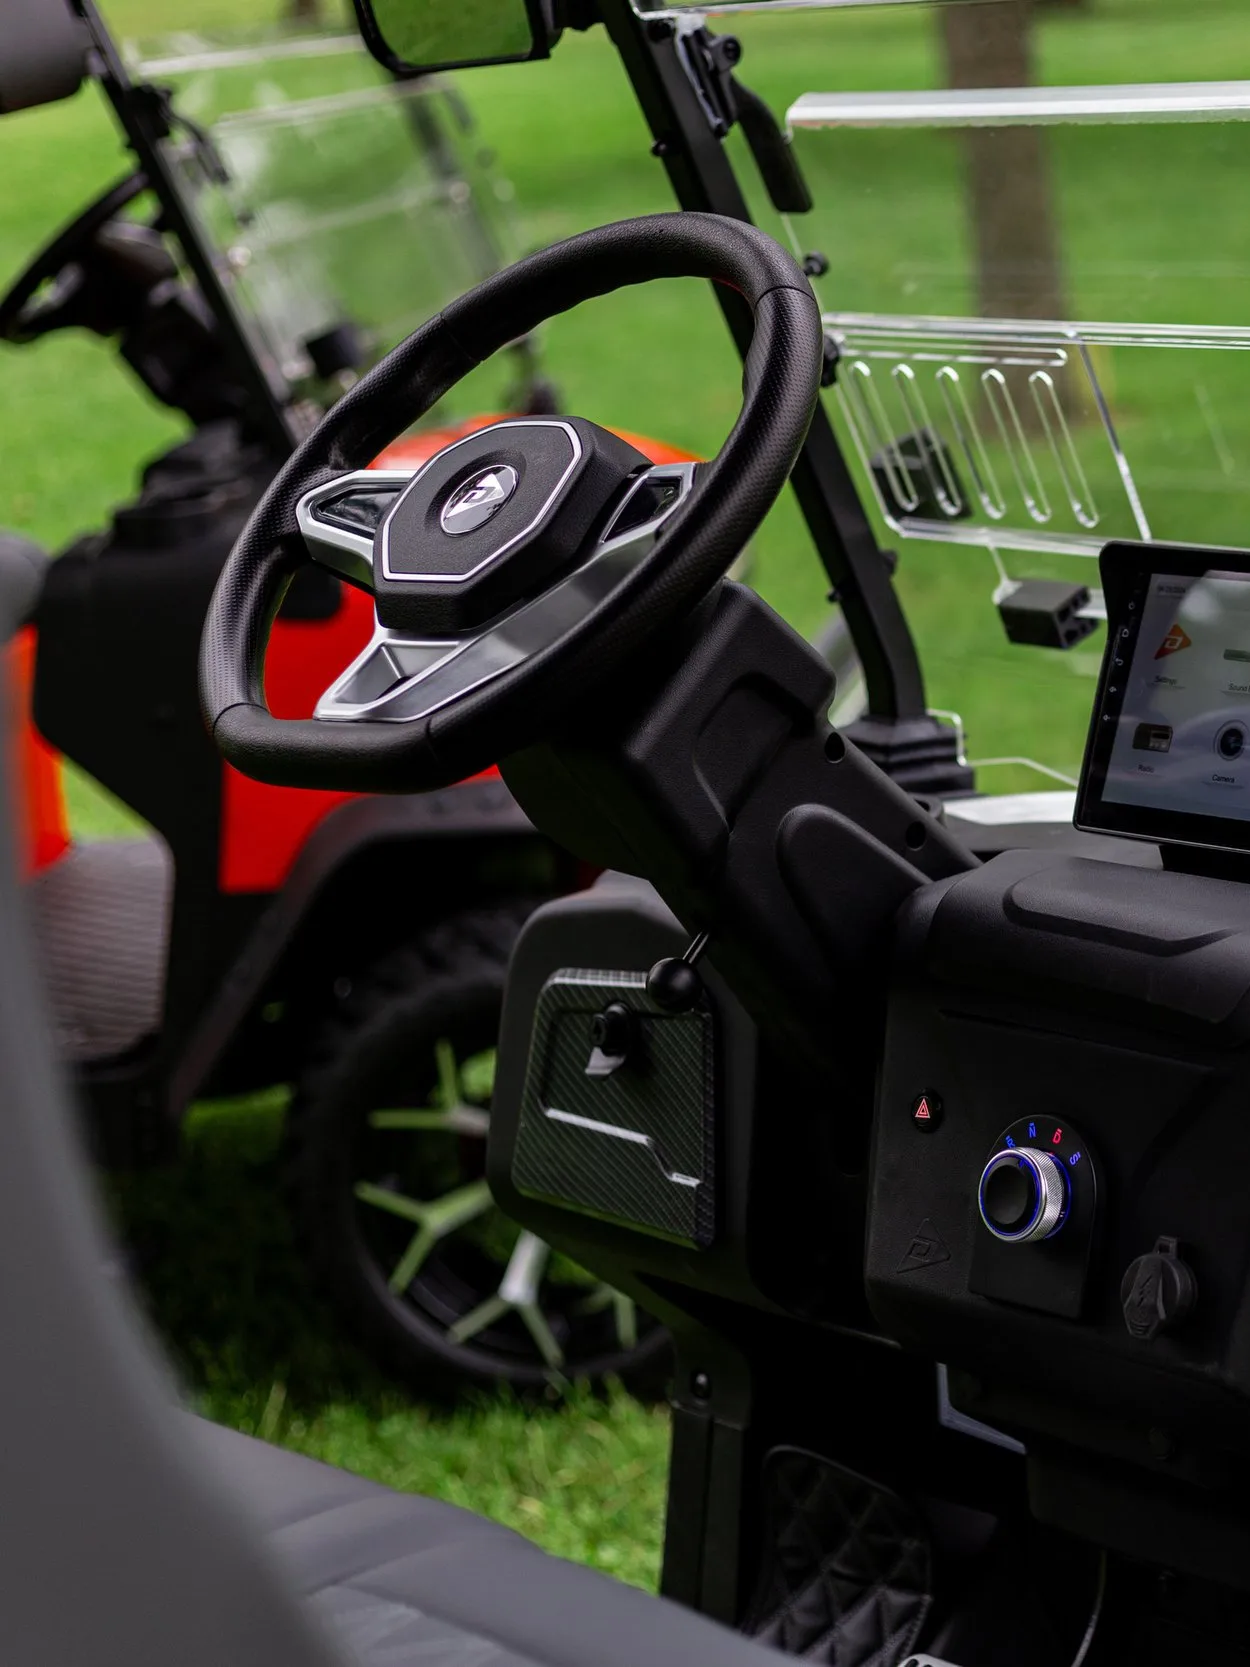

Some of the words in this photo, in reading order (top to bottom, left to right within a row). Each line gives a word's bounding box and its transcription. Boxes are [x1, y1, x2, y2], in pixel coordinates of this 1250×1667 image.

[1229, 683, 1248, 692] Sound
[1138, 764, 1154, 773] Radio
[1212, 774, 1235, 785] Camera
[1006, 1137, 1016, 1148] R
[1028, 1125, 1037, 1138] N
[1052, 1130, 1062, 1144] D
[1069, 1153, 1080, 1165] S
